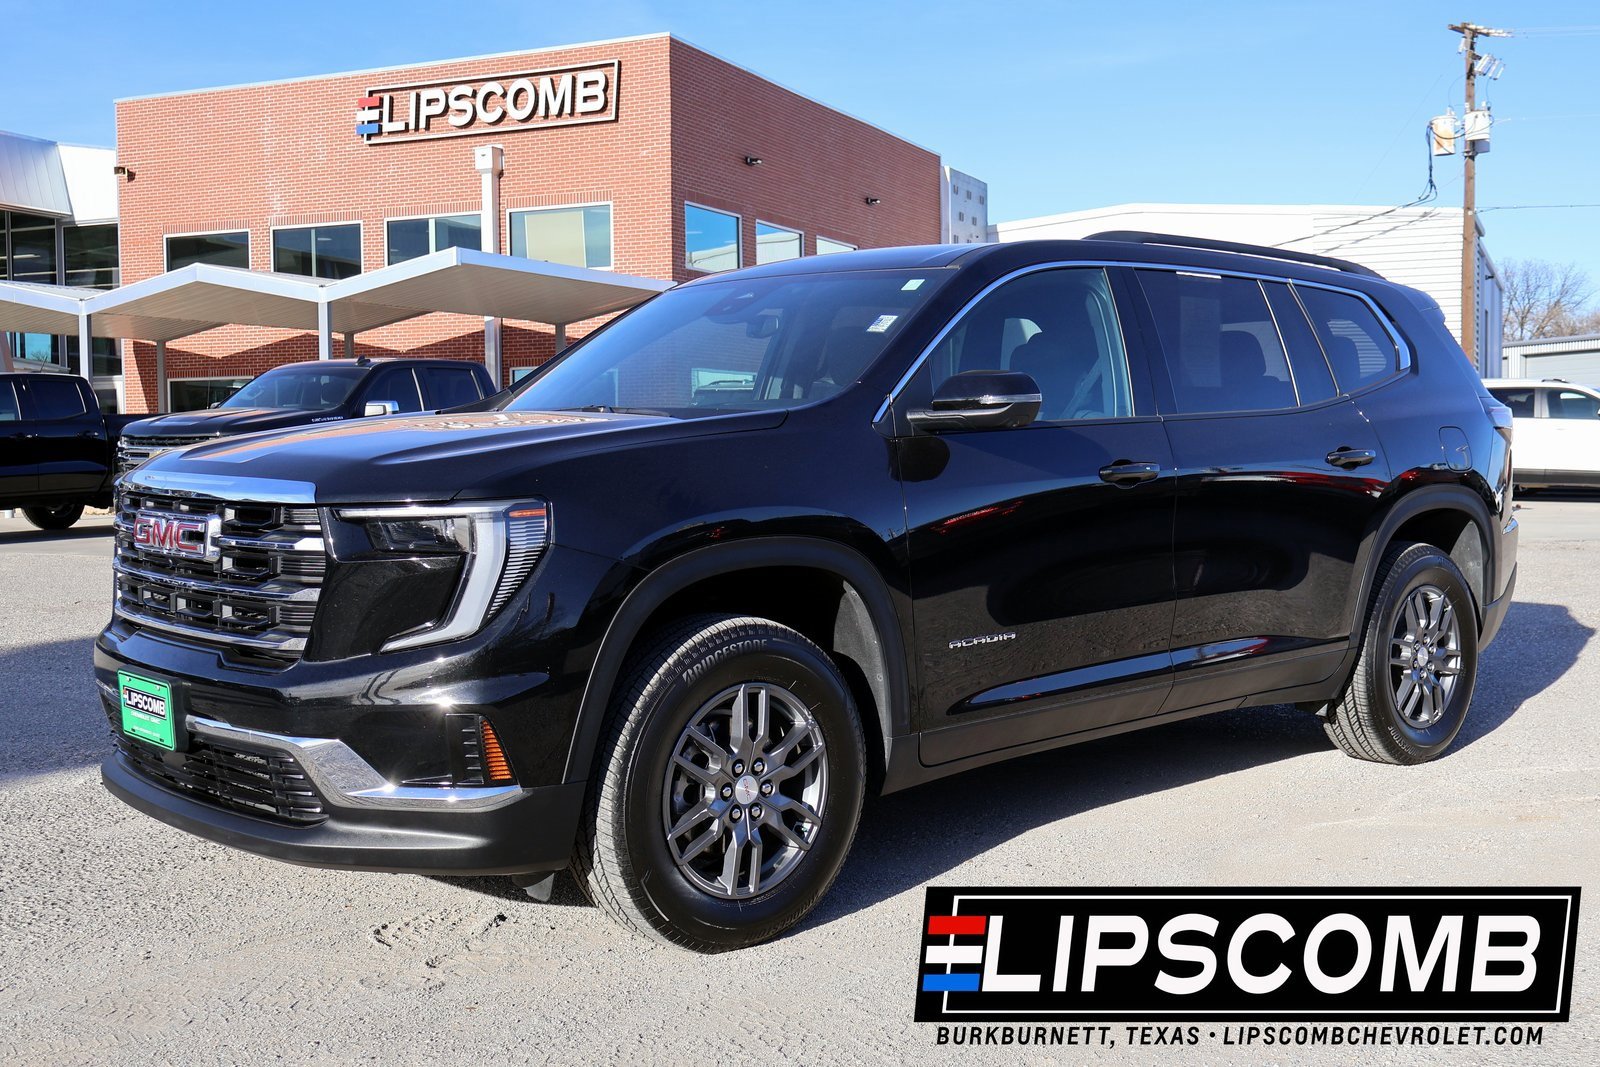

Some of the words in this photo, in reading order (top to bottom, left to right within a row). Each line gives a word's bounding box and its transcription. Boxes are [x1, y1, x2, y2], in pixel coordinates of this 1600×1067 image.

[382, 71, 606, 133] LIPSCOMB
[134, 517, 204, 554] GMC
[949, 632, 1016, 649] ACADIA
[682, 639, 768, 687] BRIDGESTONE
[126, 690, 166, 716] LIPSCOMB
